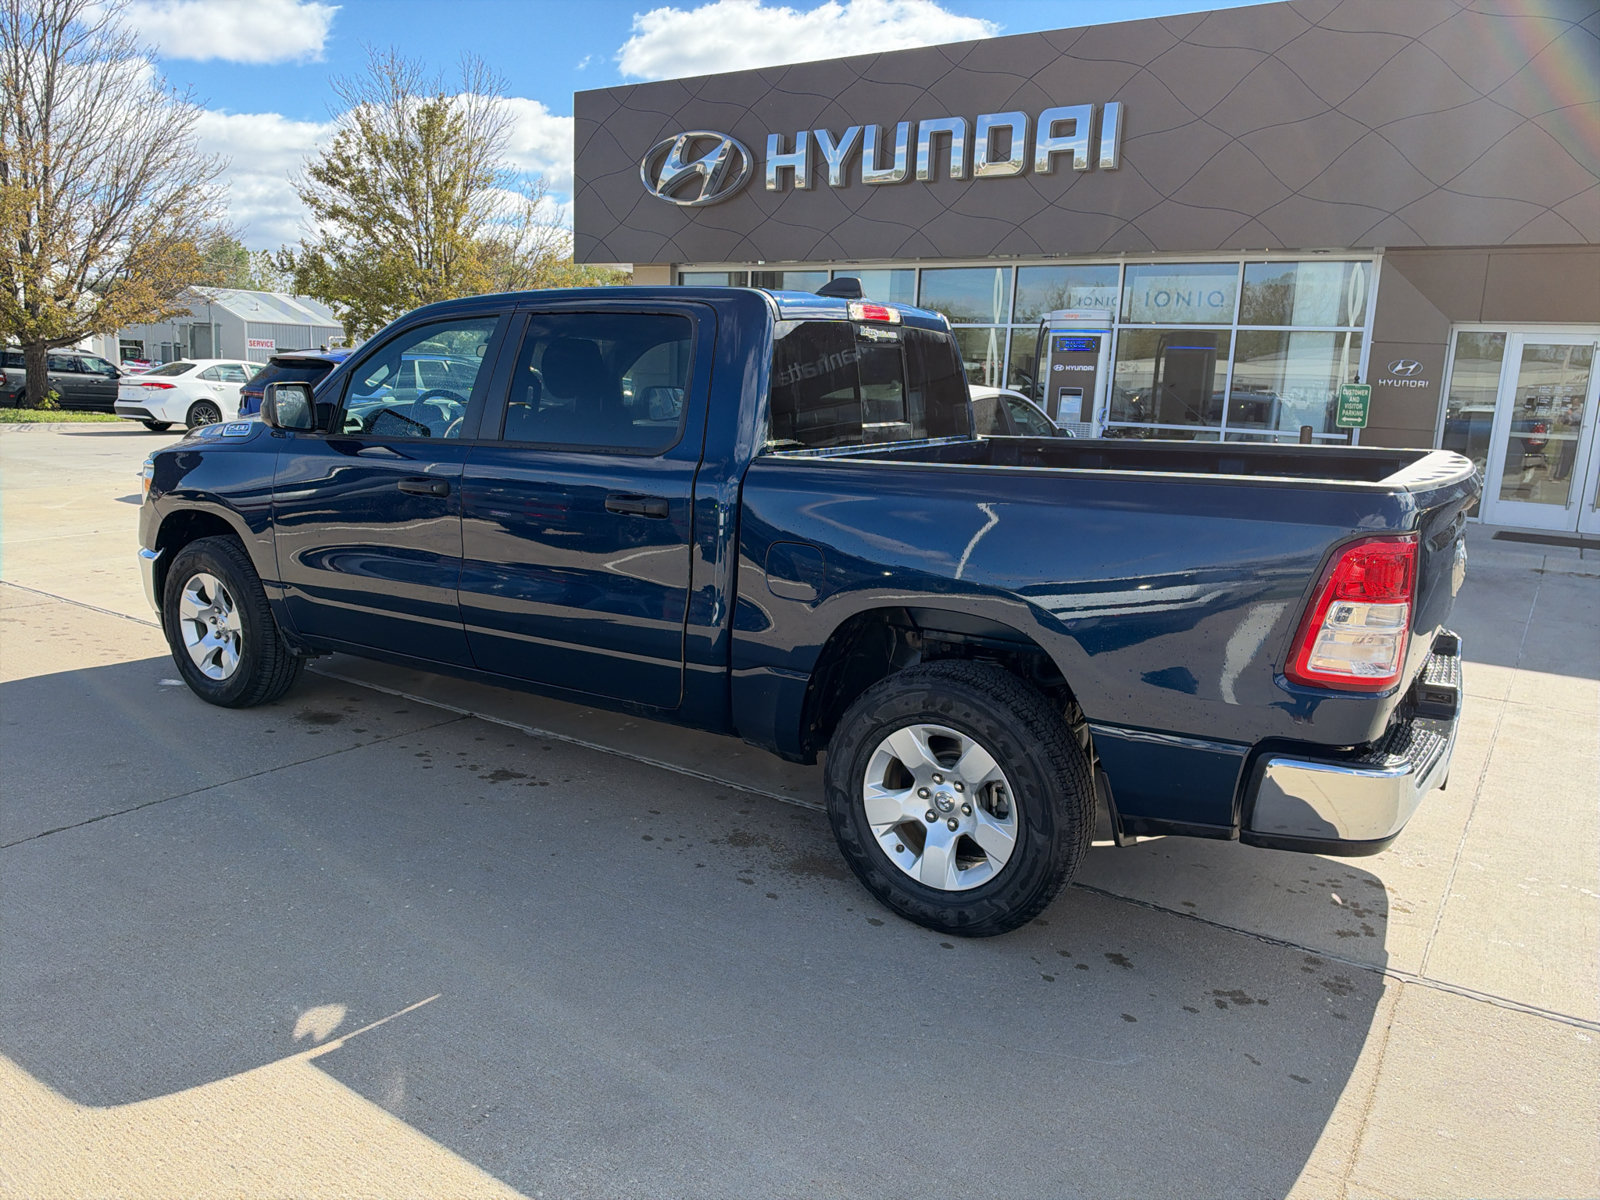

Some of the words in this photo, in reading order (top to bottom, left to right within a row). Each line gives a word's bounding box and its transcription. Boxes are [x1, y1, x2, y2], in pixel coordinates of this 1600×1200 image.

[766, 101, 1123, 191] HYUNDAI
[1145, 291, 1225, 308] IONIQ
[248, 339, 274, 349] SERVICE
[1378, 379, 1429, 388] HYUNDAI
